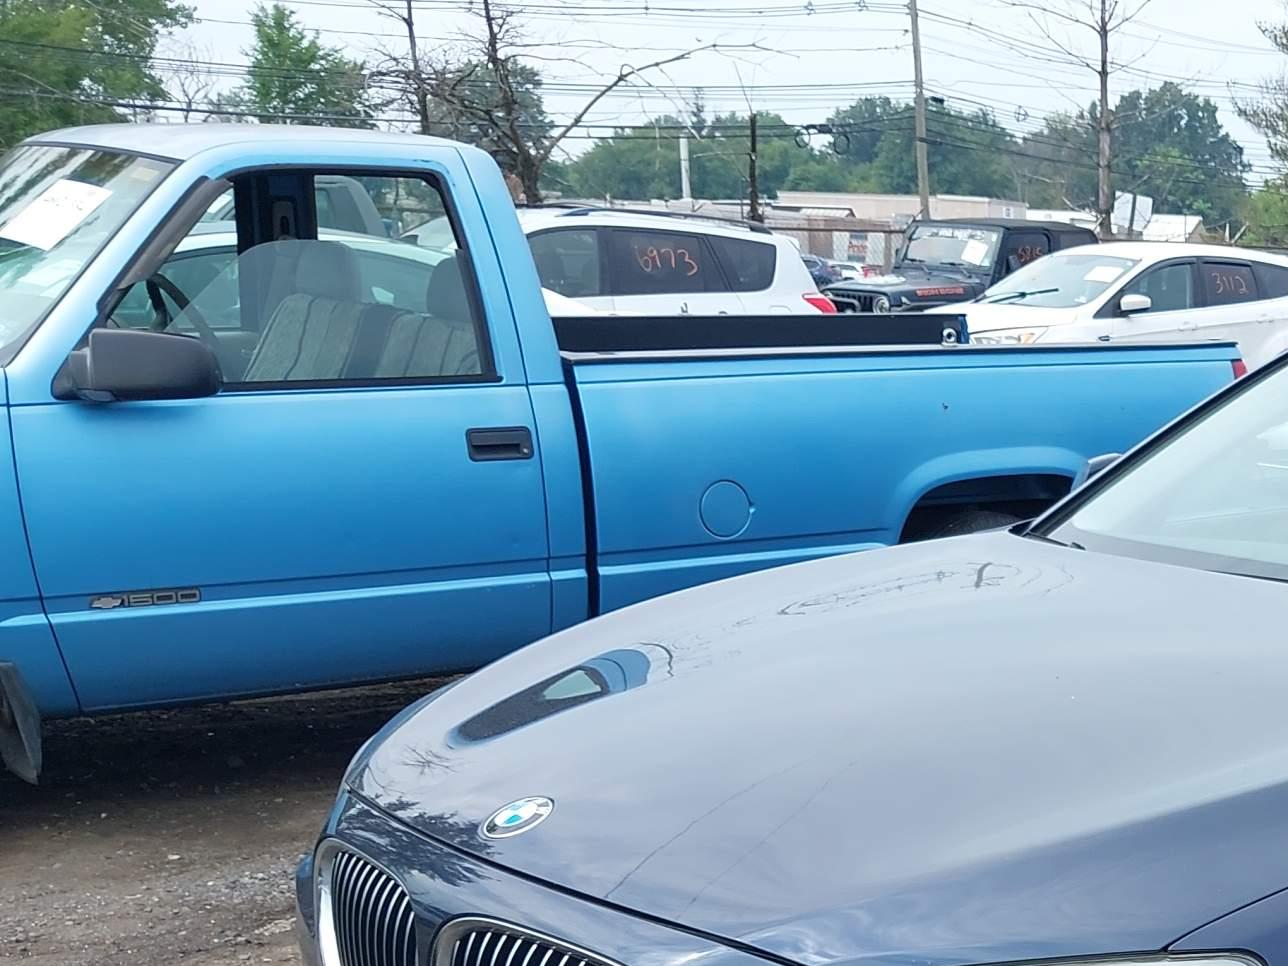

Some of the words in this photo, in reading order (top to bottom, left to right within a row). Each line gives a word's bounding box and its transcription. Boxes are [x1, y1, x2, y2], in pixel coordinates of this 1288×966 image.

[634, 245, 698, 276] 6973
[1211, 272, 1248, 294] 3112
[123, 590, 200, 607] 1500
